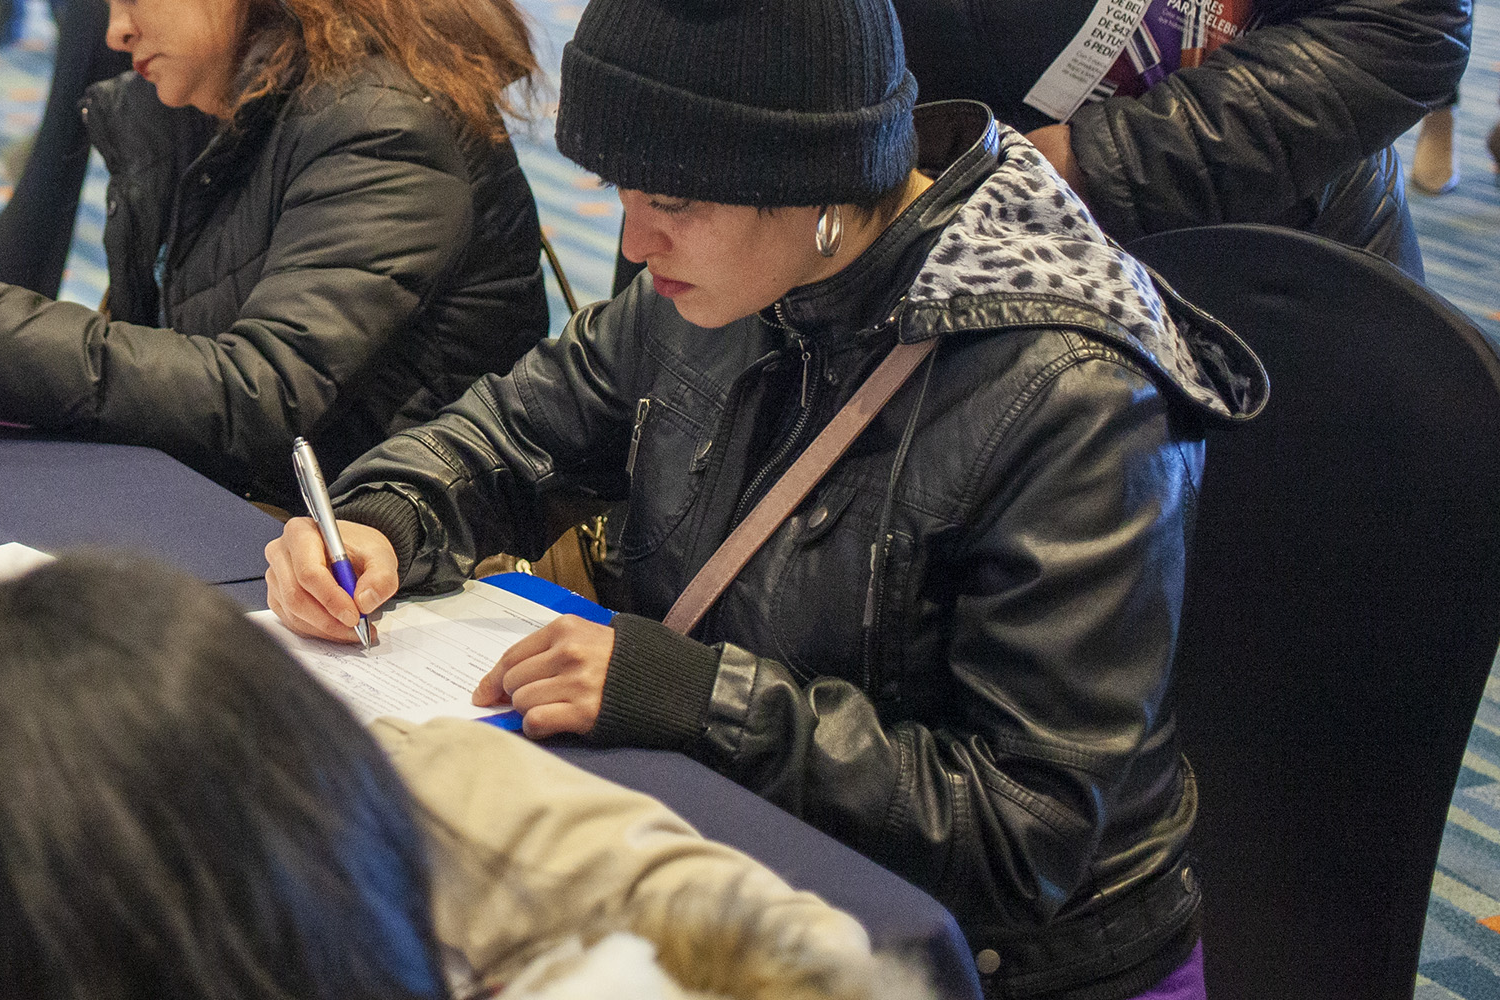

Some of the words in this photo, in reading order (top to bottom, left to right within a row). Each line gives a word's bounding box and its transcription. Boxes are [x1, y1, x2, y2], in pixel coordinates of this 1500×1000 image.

[1098, 16, 1112, 30] DE
[1106, 5, 1114, 16] Y
[1113, 10, 1136, 27] GAN
[1090, 27, 1107, 40] EN
[1083, 39, 1091, 48] 6
[1090, 42, 1117, 60] PEDI
